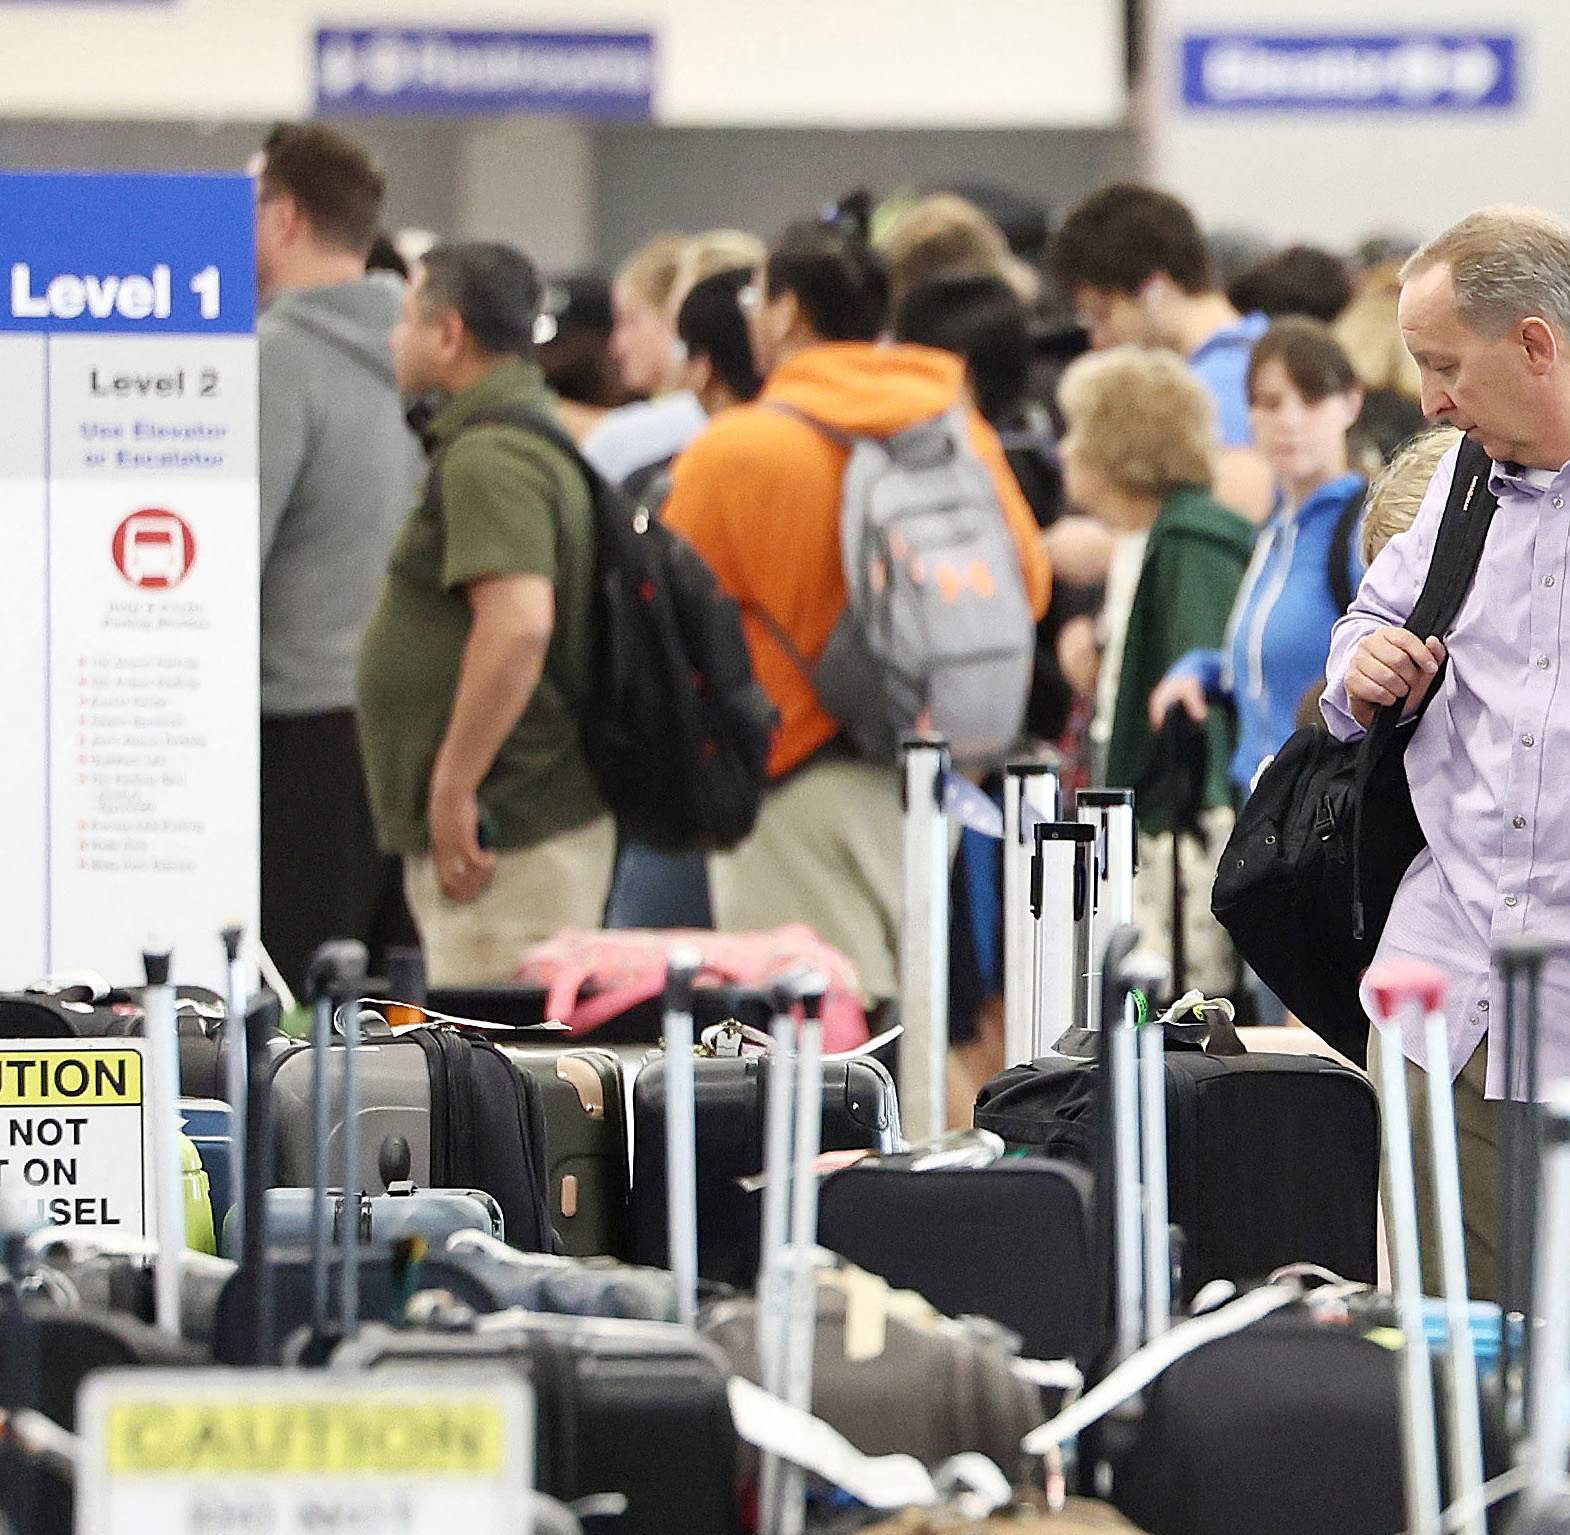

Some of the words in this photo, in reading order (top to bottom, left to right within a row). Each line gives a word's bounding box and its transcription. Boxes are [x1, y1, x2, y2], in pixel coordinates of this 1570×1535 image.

[11, 262, 170, 319] Level
[189, 265, 220, 319] 1
[90, 368, 184, 396] Level
[201, 369, 219, 397] 2
[0, 1059, 126, 1097] TION
[9, 1118, 88, 1146] NOT
[23, 1158, 76, 1186] ON
[122, 1404, 486, 1468] CAUTION
